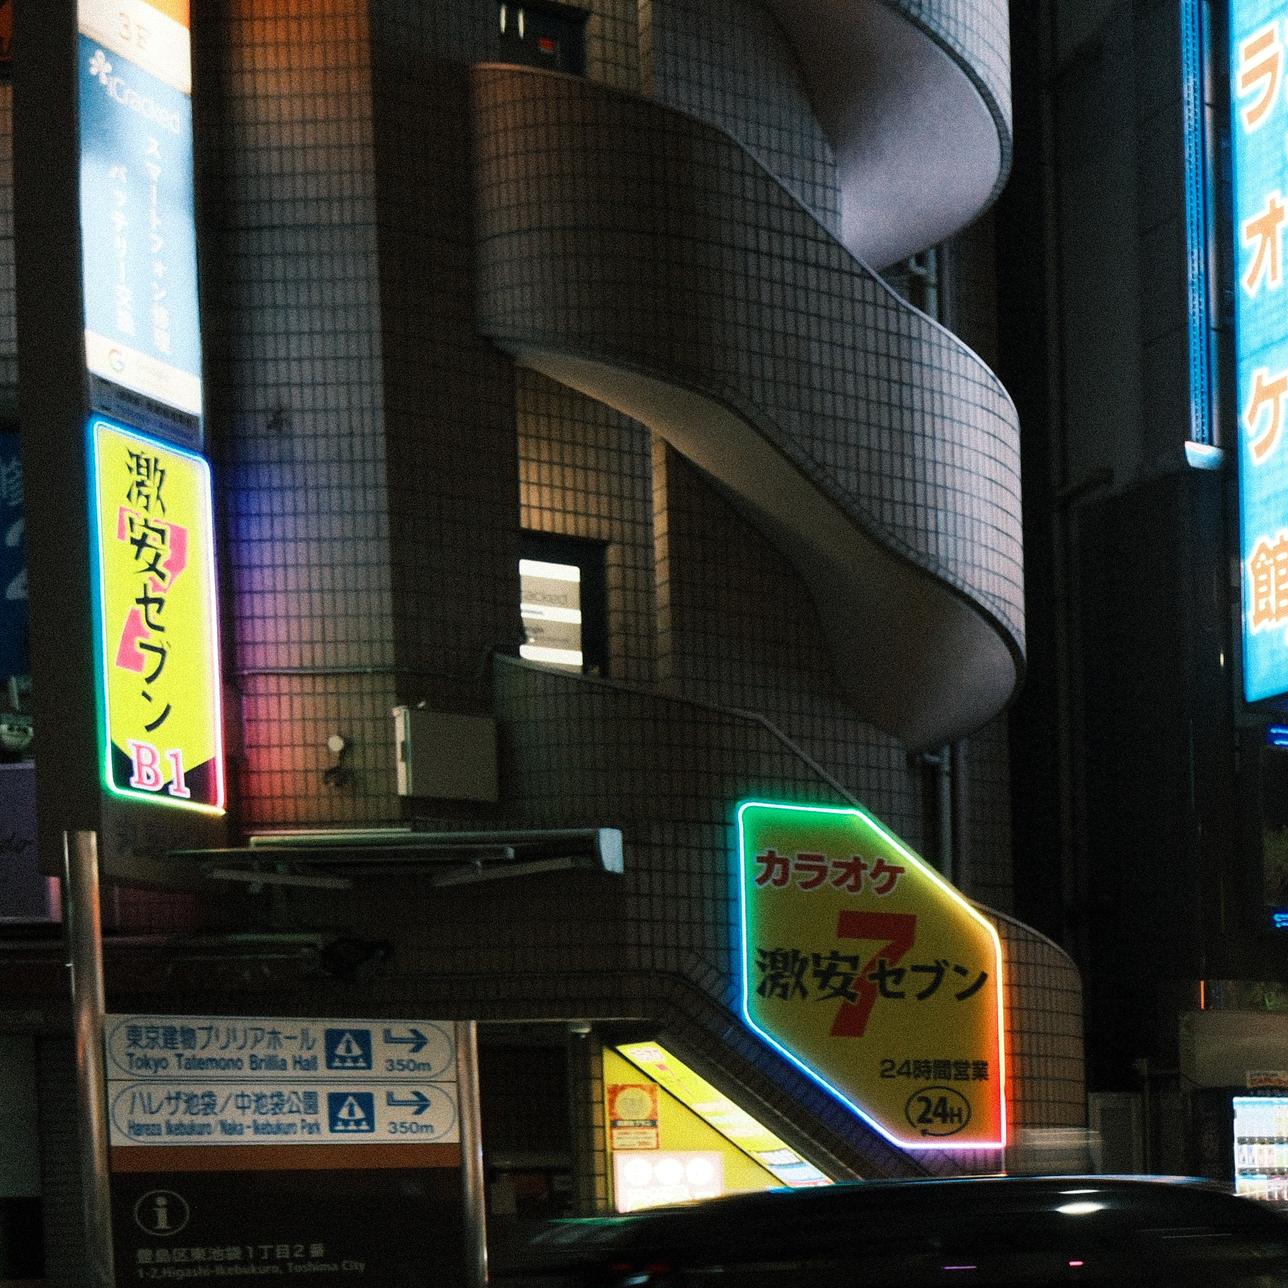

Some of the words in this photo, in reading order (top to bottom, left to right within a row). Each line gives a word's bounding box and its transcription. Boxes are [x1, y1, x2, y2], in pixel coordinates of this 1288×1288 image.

[125, 445, 173, 734] 激安セブン
[130, 739, 192, 800] B1
[754, 848, 906, 895] カラオケ
[755, 948, 989, 1003] 激安セブン
[828, 909, 917, 1039] 7
[126, 1052, 170, 1074] Tokyo
[292, 1055, 319, 1071] Hall
[385, 1058, 433, 1074] 350m
[879, 1058, 990, 1082] 24時間営業
[915, 1096, 964, 1126] 24H
[388, 1121, 435, 1136] 350m
[341, 1259, 366, 1275] City
